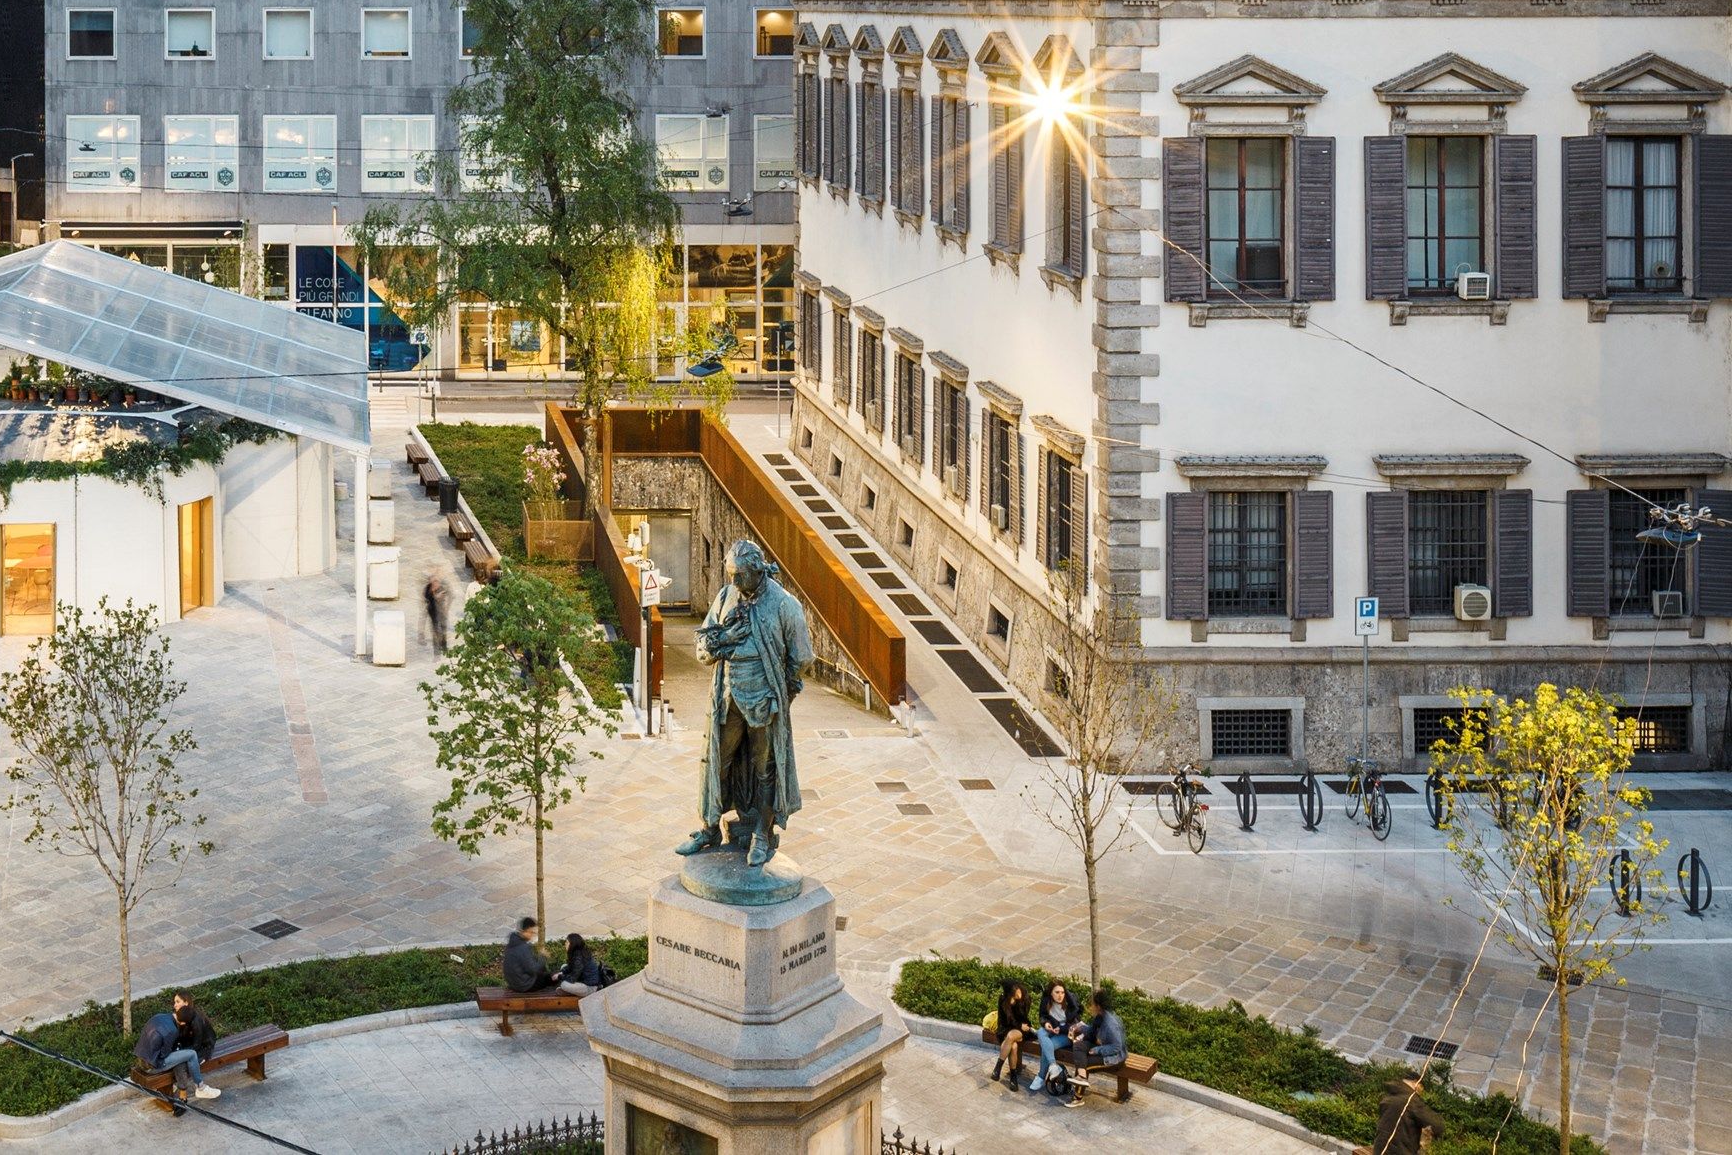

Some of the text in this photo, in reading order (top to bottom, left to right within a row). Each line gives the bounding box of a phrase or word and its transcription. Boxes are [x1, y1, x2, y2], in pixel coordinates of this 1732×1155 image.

[299, 277, 312, 288] LE
[299, 289, 316, 302] PIÙ
[1362, 601, 1372, 615] P
[798, 931, 826, 952] MILANO
[656, 935, 741, 971] CESARE BECCARIA
[788, 952, 812, 971] MARZO
[814, 945, 827, 958] 1738
